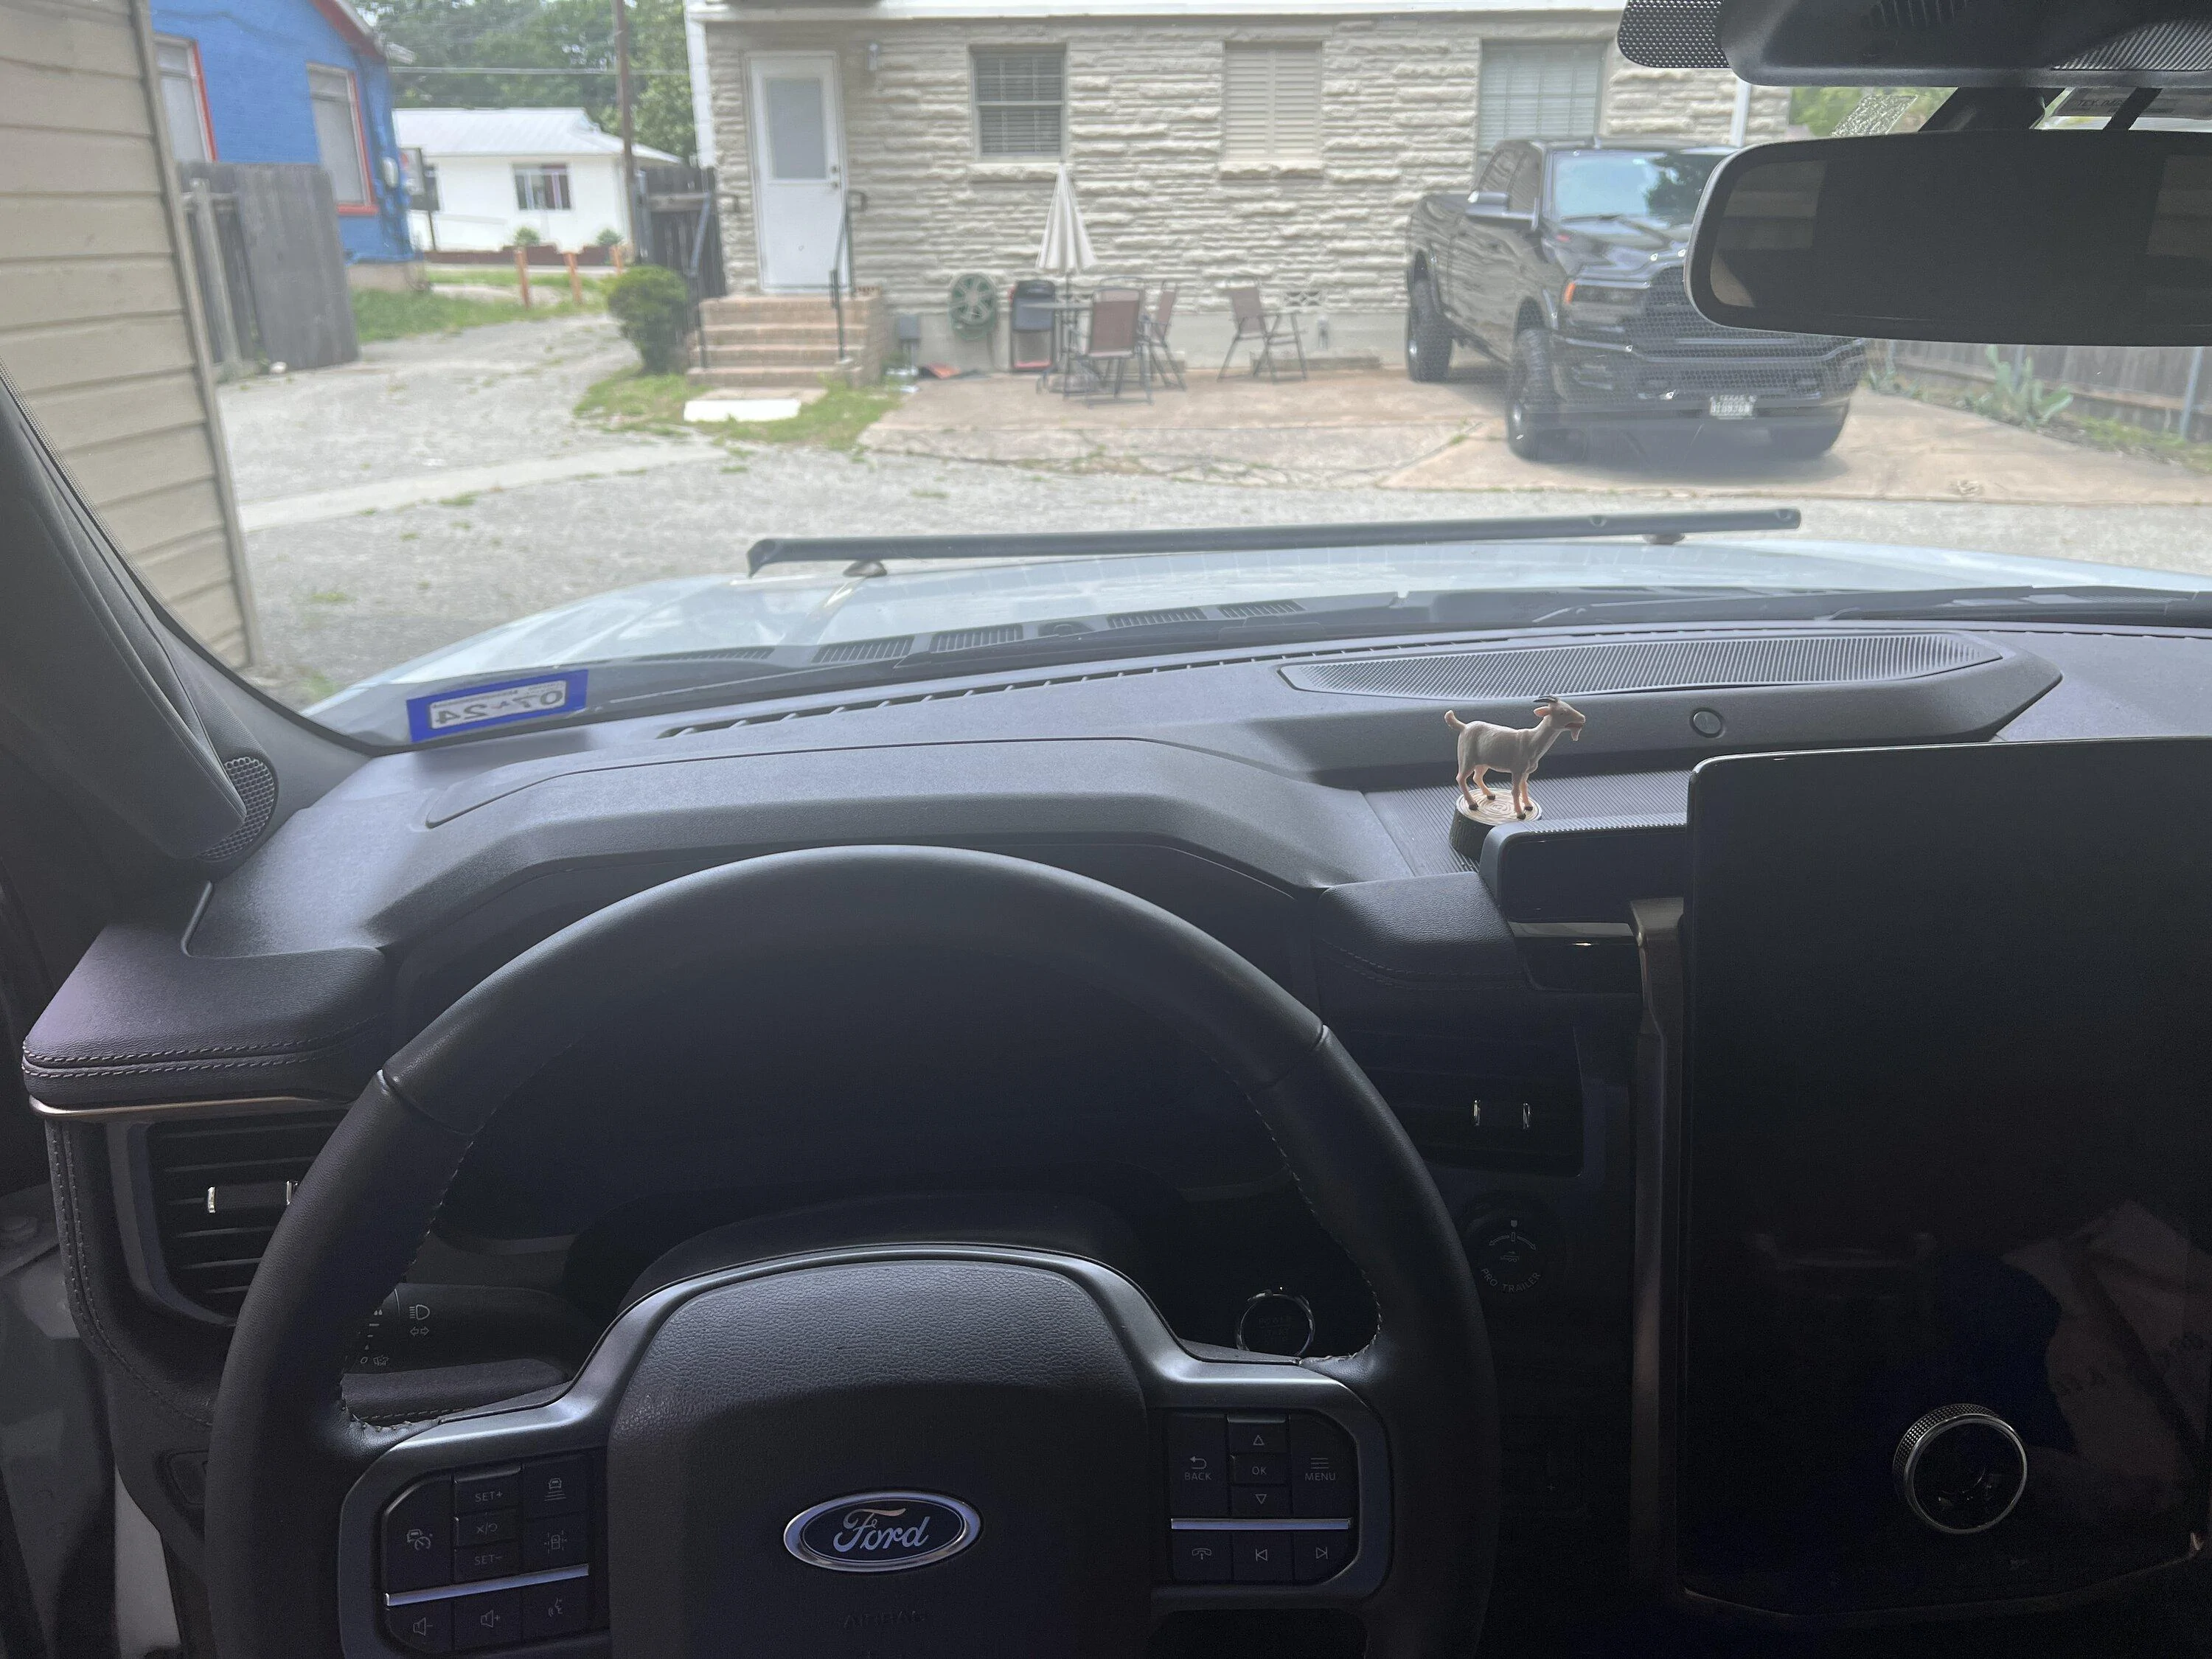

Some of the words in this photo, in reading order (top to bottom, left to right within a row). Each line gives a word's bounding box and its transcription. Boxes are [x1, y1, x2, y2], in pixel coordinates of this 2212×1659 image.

[1481, 1267, 1498, 1287] PRO
[1501, 1272, 1541, 1293] TRAILER
[1251, 1466, 1267, 1475] OK
[1184, 1472, 1212, 1481] BACK
[1304, 1472, 1336, 1481] MENU
[832, 1507, 931, 1553] Ford
